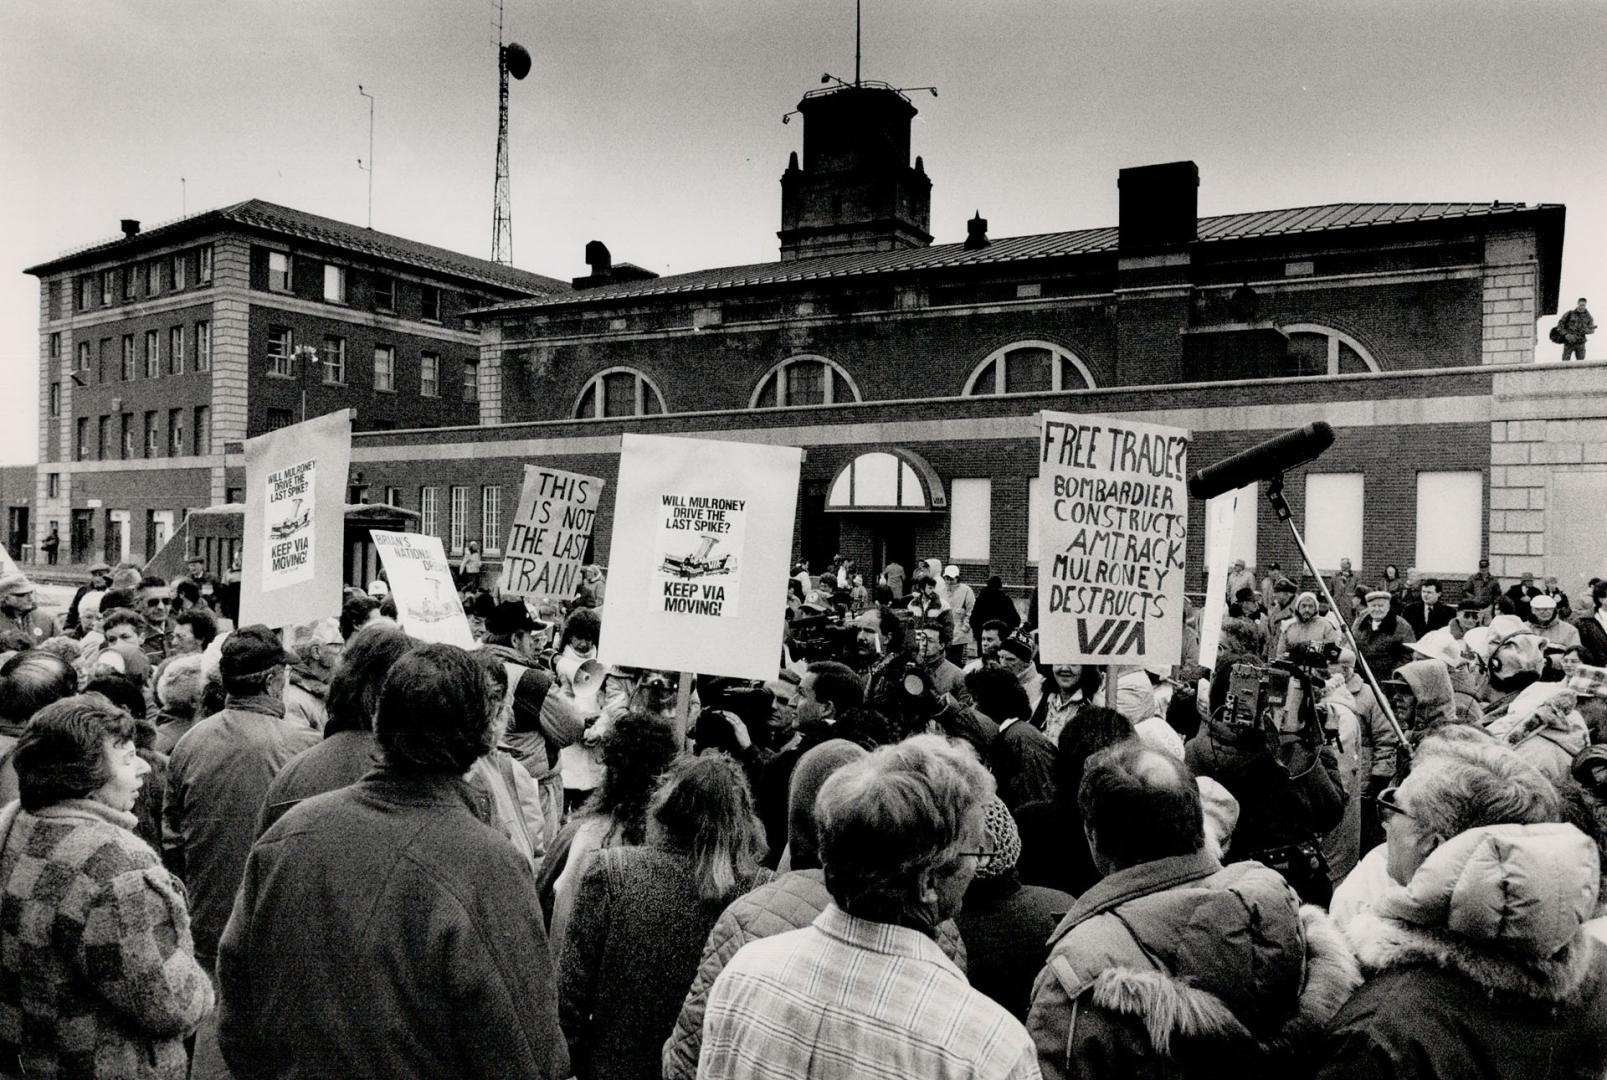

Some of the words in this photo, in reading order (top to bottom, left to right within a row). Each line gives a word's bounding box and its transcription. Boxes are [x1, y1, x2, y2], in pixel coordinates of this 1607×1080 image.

[1043, 421, 1101, 469] FREE
[1108, 427, 1188, 482] TRADE?
[268, 472, 282, 484] WILL
[284, 460, 316, 478] MULRONEY
[274, 479, 293, 492] DRIVE
[294, 473, 305, 484] THE
[271, 489, 287, 503] LAST
[288, 481, 309, 497] SPIKE?
[539, 472, 589, 504] THIS
[1054, 474, 1174, 510] BOMBARDIER
[530, 500, 552, 524] IS
[562, 506, 595, 530] NOT
[662, 494, 686, 507] WILL
[689, 496, 746, 511] MULRONEY
[673, 507, 704, 520] DRIVE
[706, 509, 726, 521] THE
[665, 518, 692, 530] LAST
[694, 520, 731, 534] SPIKE?
[1054, 499, 1186, 539] CONSTRUCTS
[271, 541, 293, 559] KEEP
[294, 537, 309, 552] VIA
[375, 534, 411, 547] BRIAN'S
[513, 524, 548, 555] THE
[552, 531, 591, 560] LAST
[1066, 528, 1185, 570] AMTRACK.
[272, 551, 307, 572] MOVING!
[1052, 554, 1169, 590] MULRONEY
[507, 556, 578, 595] TRAIN
[664, 581, 698, 598] KEEP
[703, 585, 725, 601] VIA
[1050, 584, 1168, 620] DESTRUCTS
[664, 597, 722, 616] MOVING!
[1077, 618, 1145, 655] VIA
